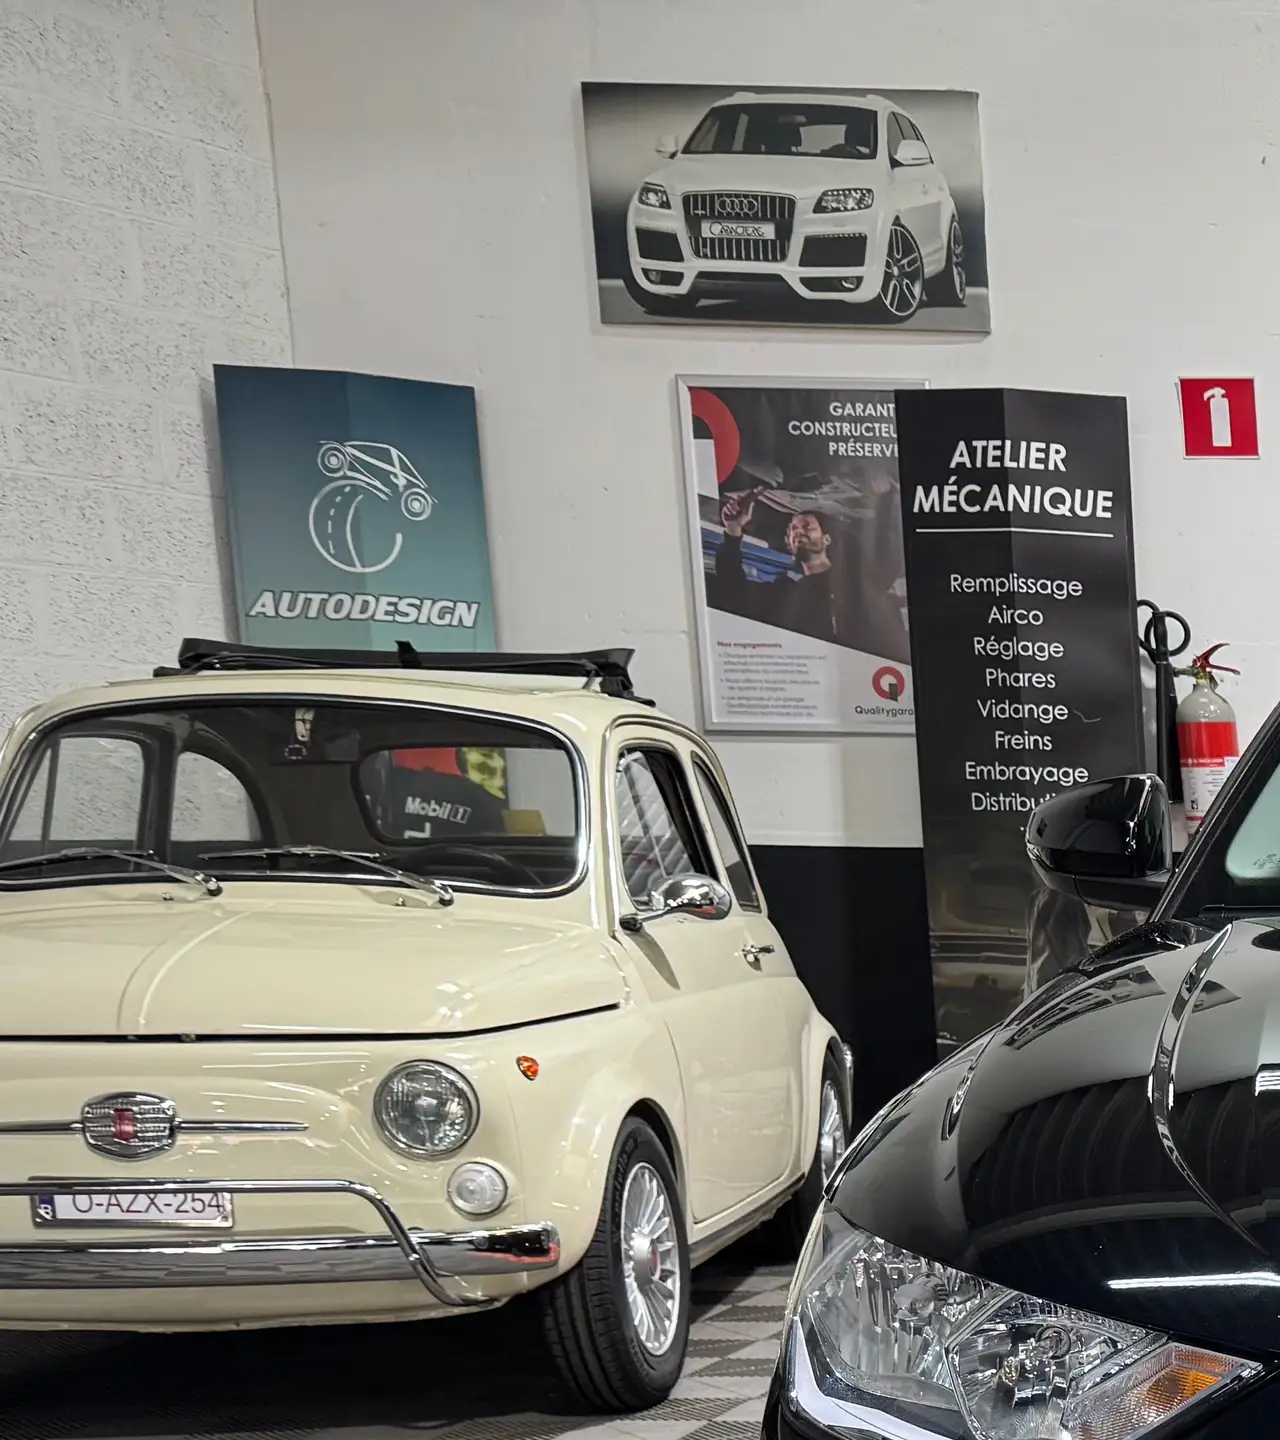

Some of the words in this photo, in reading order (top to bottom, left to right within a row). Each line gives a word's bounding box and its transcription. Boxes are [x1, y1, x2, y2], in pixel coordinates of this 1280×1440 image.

[950, 440, 1066, 471] ATELIER
[913, 476, 1113, 518] MÉCANIQUE
[950, 573, 1083, 599] Remplissage
[246, 590, 480, 628] AUTODESIGN
[988, 604, 1043, 625] Airco
[973, 636, 1064, 661] Réglage
[986, 668, 1056, 688] Phares
[977, 699, 1068, 724] Vidange
[995, 731, 1052, 750] Freins
[965, 761, 1089, 787] Embrayage
[405, 795, 450, 820] Mobil
